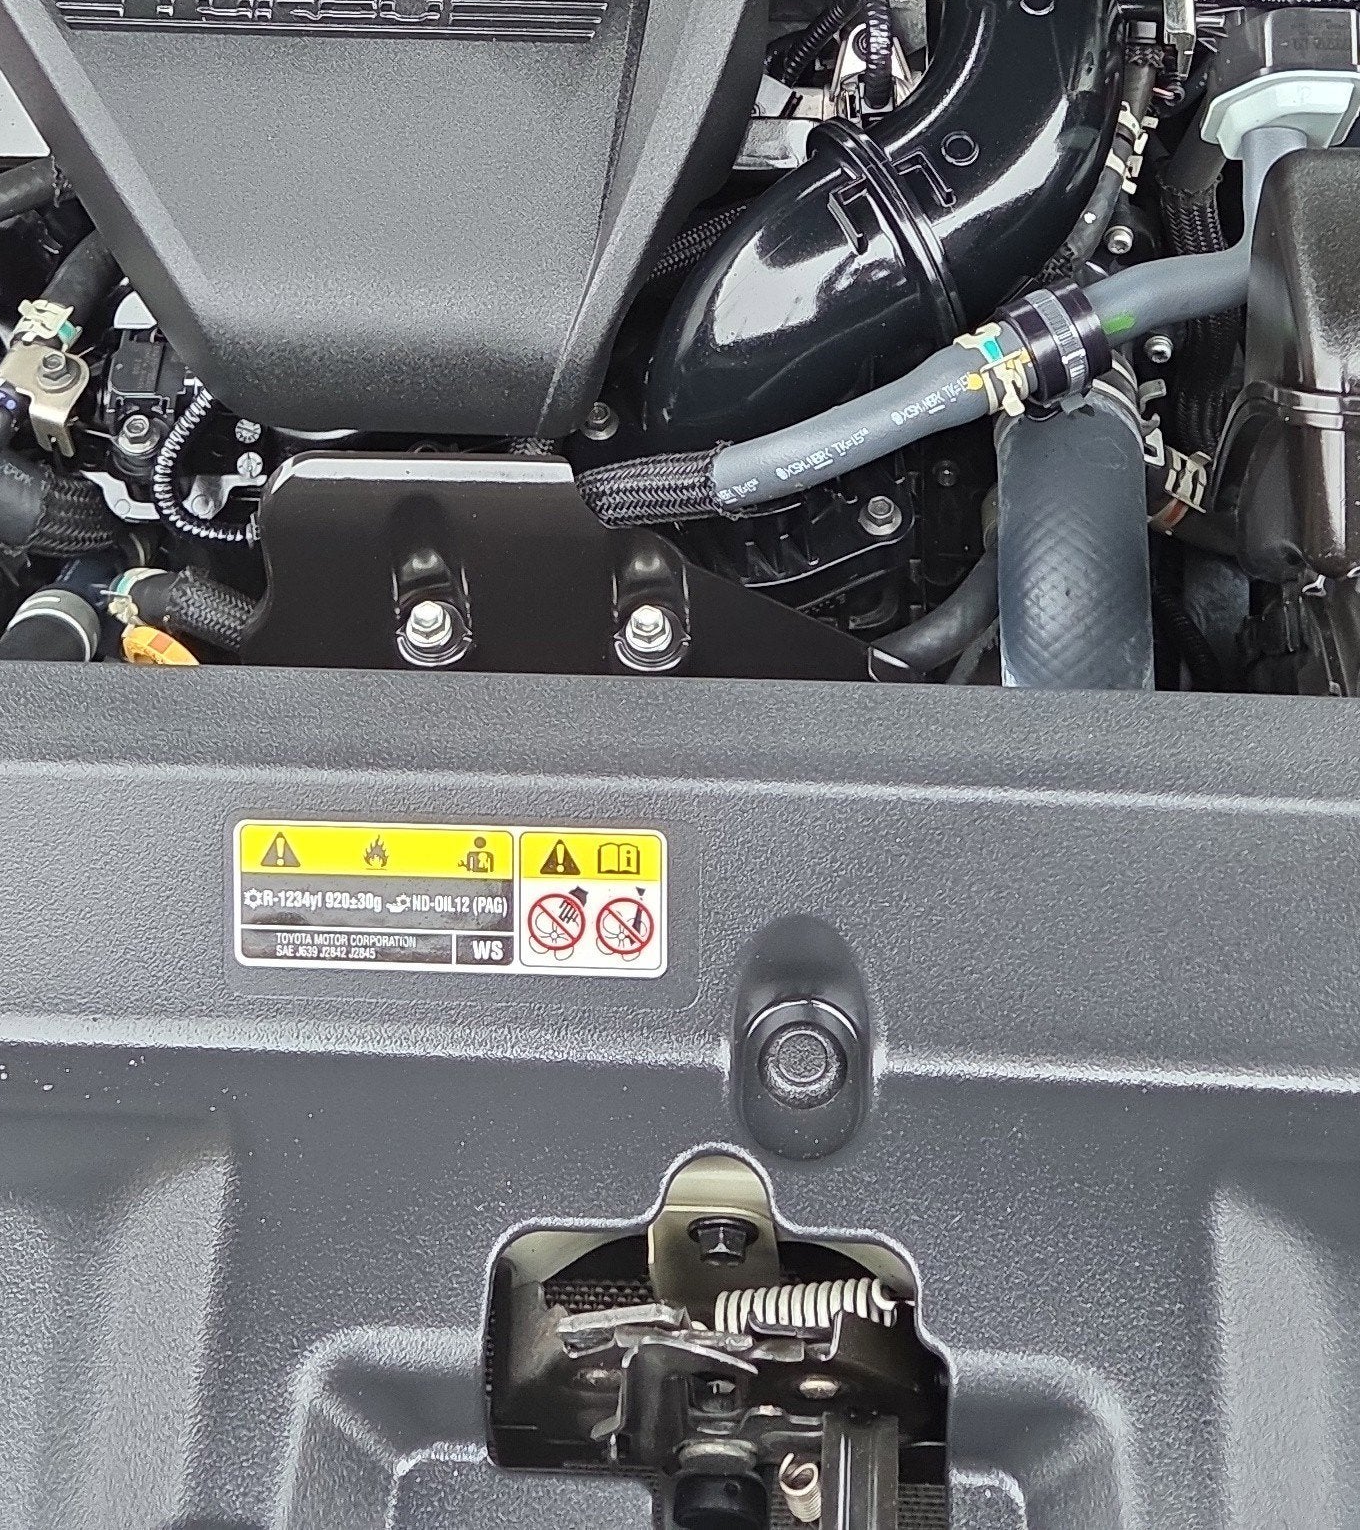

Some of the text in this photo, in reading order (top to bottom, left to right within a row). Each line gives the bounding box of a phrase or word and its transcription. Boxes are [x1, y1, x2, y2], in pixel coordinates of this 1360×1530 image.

[325, 891, 382, 913] 920±30g
[472, 896, 508, 917] (PAG)
[276, 933, 417, 948] TOYOTA MOTOR CORPORATION
[276, 946, 295, 957] SAE
[296, 947, 318, 958] J639
[472, 940, 504, 961] WS
